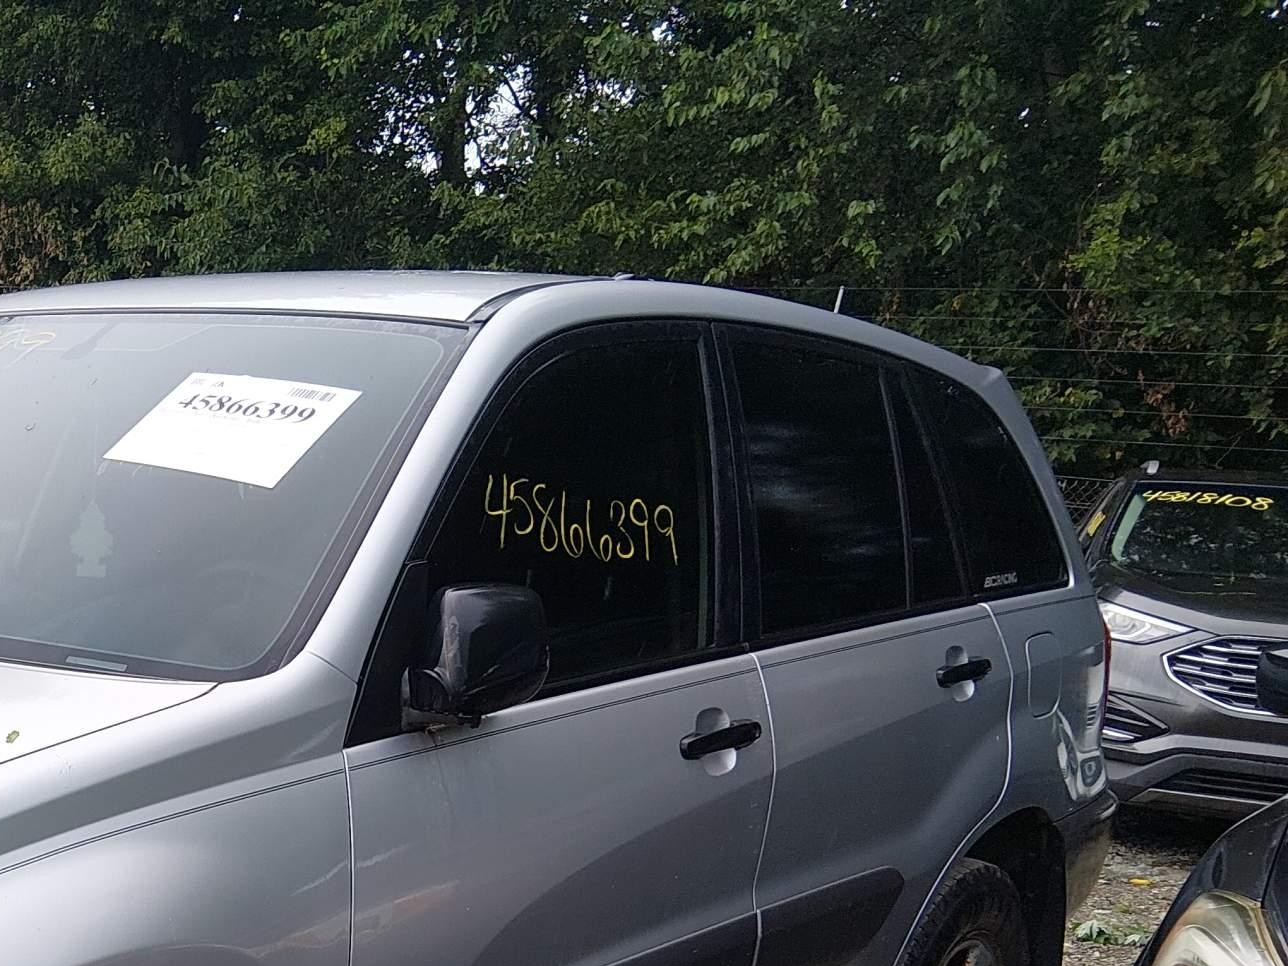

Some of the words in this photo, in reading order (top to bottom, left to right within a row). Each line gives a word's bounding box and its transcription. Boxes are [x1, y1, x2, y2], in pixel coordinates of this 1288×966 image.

[178, 393, 316, 423] 45866399
[1142, 490, 1274, 510] 45818108
[485, 473, 678, 566] 45866399
